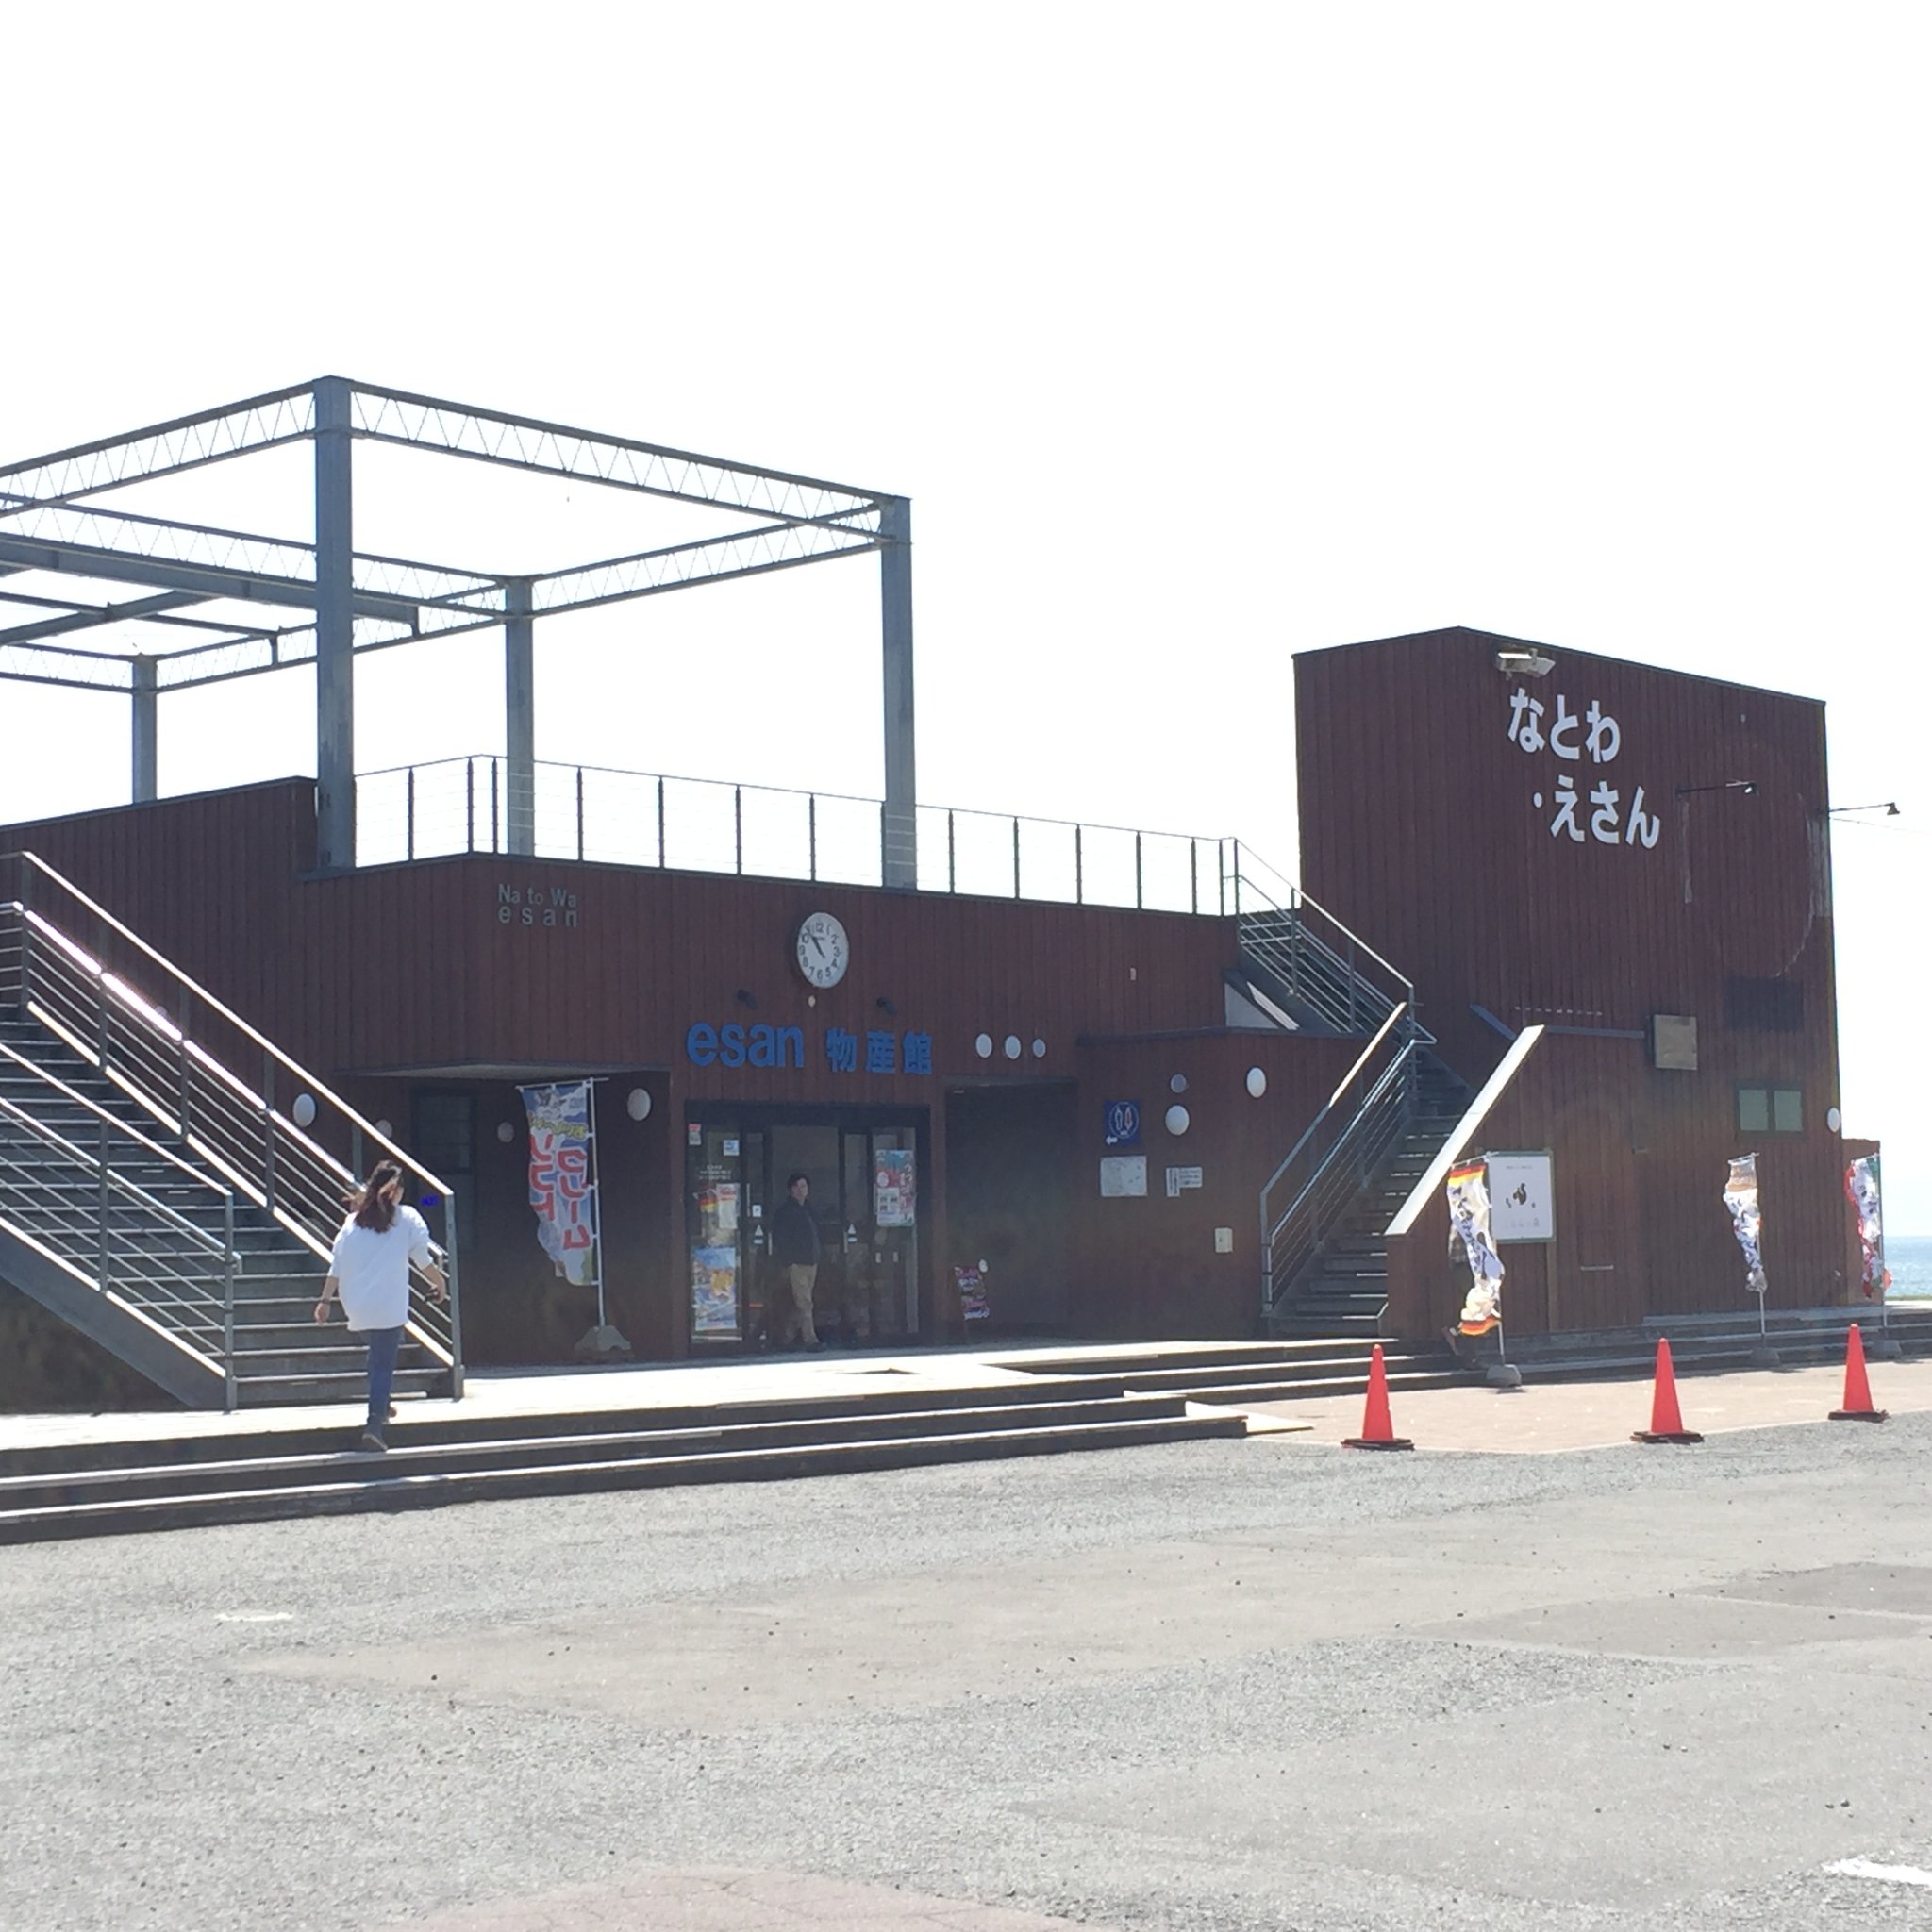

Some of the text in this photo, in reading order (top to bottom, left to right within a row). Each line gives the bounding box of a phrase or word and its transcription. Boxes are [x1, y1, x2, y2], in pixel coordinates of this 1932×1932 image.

[1507, 687, 1621, 763] なとわ
[498, 883, 521, 904] Na
[550, 887, 576, 908] Wa
[687, 1023, 933, 1074] esan 物産館
